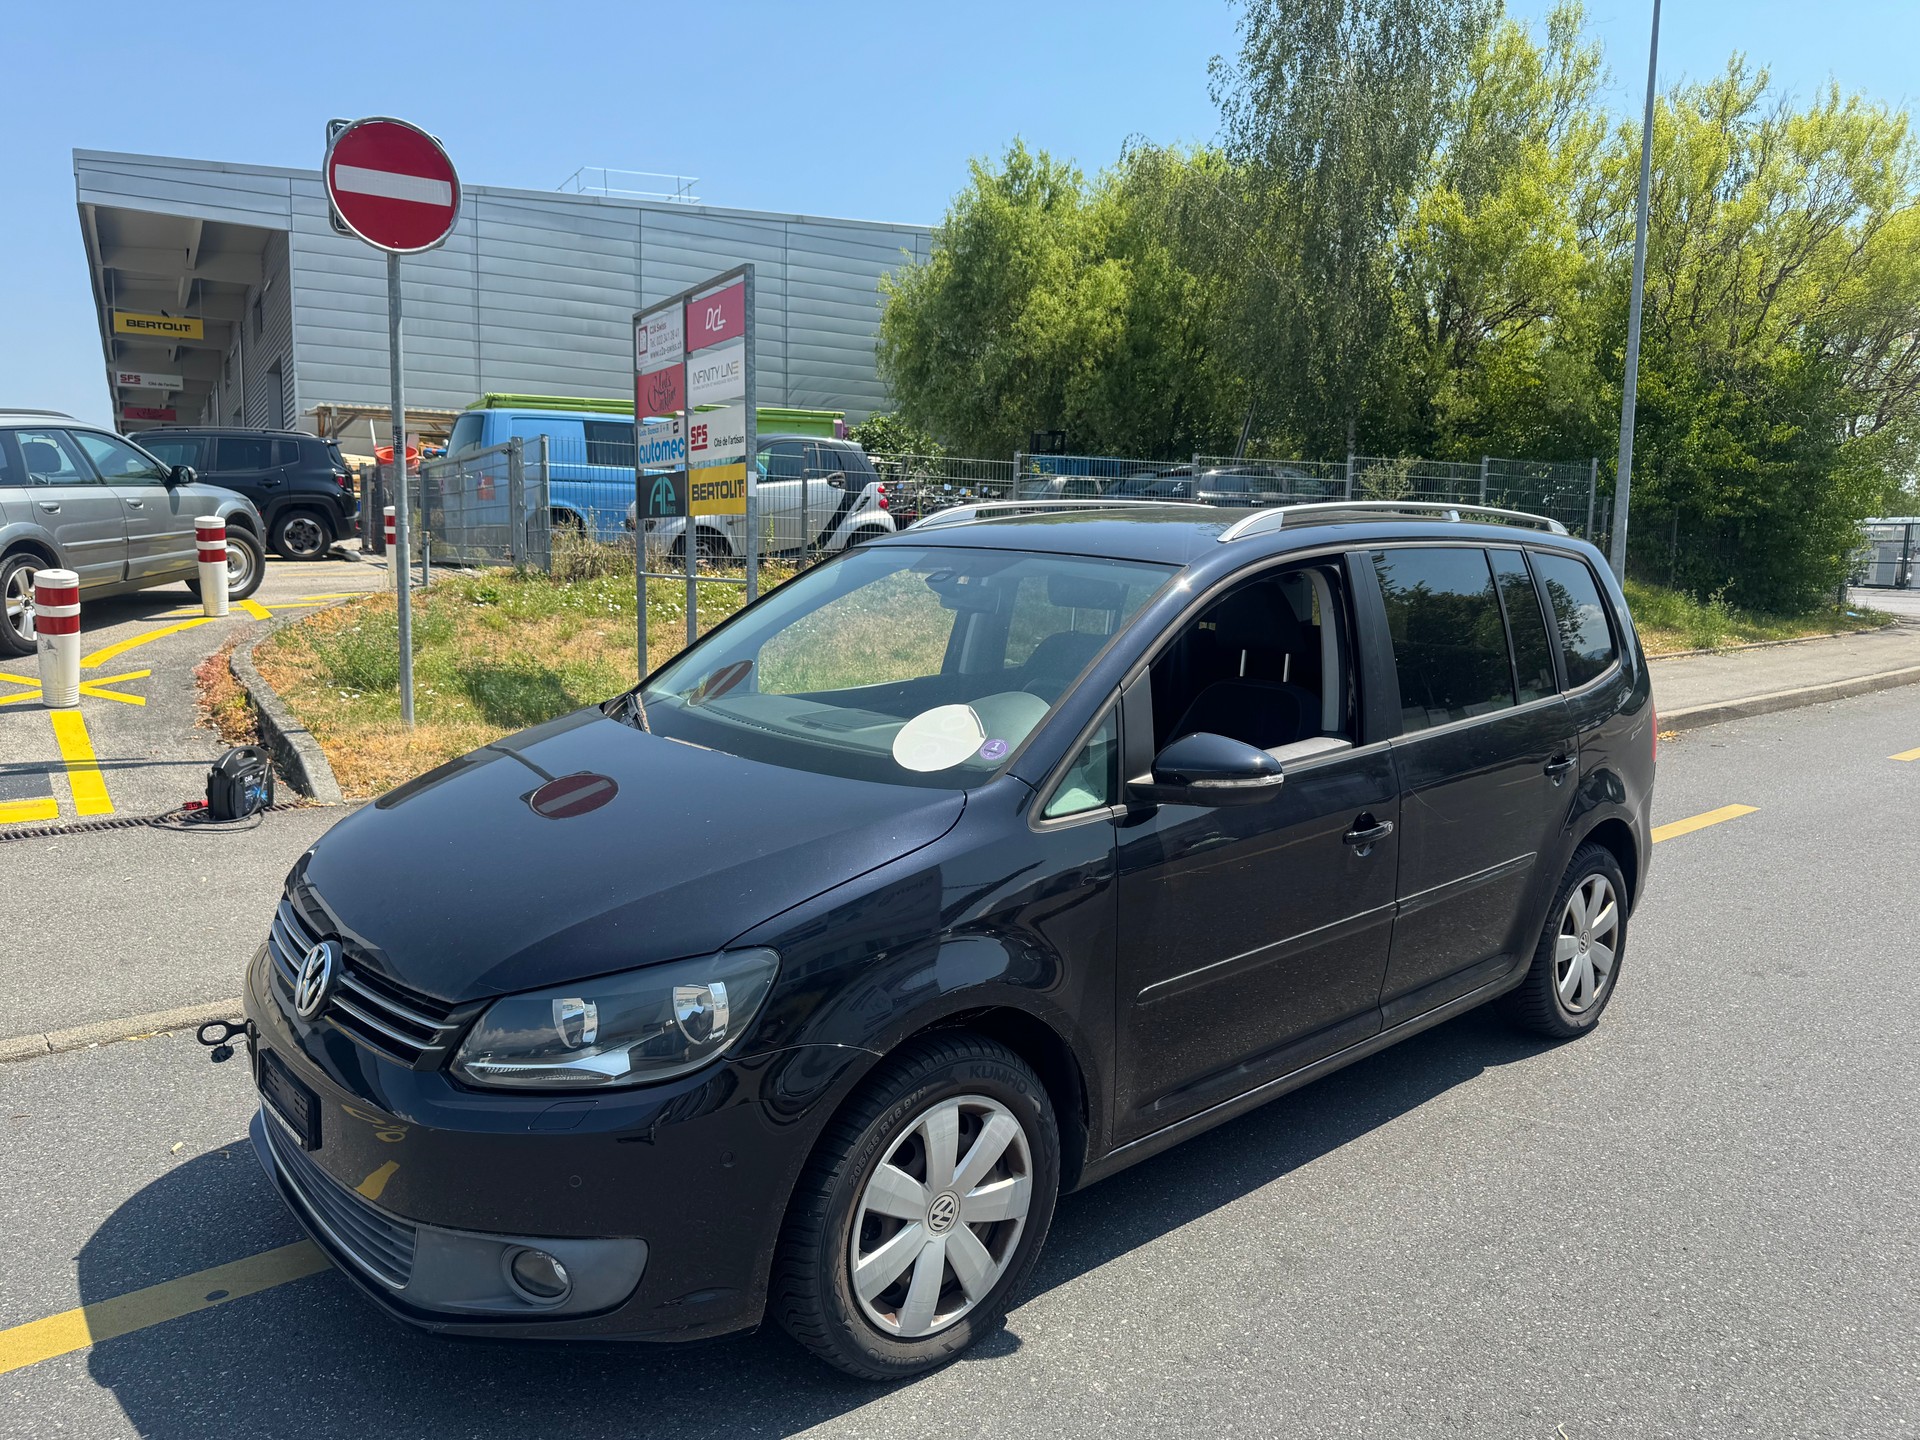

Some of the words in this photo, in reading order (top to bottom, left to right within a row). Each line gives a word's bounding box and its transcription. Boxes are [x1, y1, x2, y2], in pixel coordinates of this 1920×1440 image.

[705, 304, 726, 331] DCL
[120, 374, 141, 382] SFS
[693, 365, 720, 384] INFINITY
[721, 360, 739, 378] LINE
[691, 424, 708, 445] SFS
[714, 437, 722, 448] Cité
[722, 437, 728, 446] de
[728, 434, 744, 445] l'artisan
[640, 437, 685, 464] automec
[692, 479, 744, 501] BERTOLIT
[969, 1064, 1028, 1095] KUMHO
[849, 1134, 880, 1186] 205/55
[880, 1107, 902, 1135] R16
[903, 1086, 927, 1110] 91H
